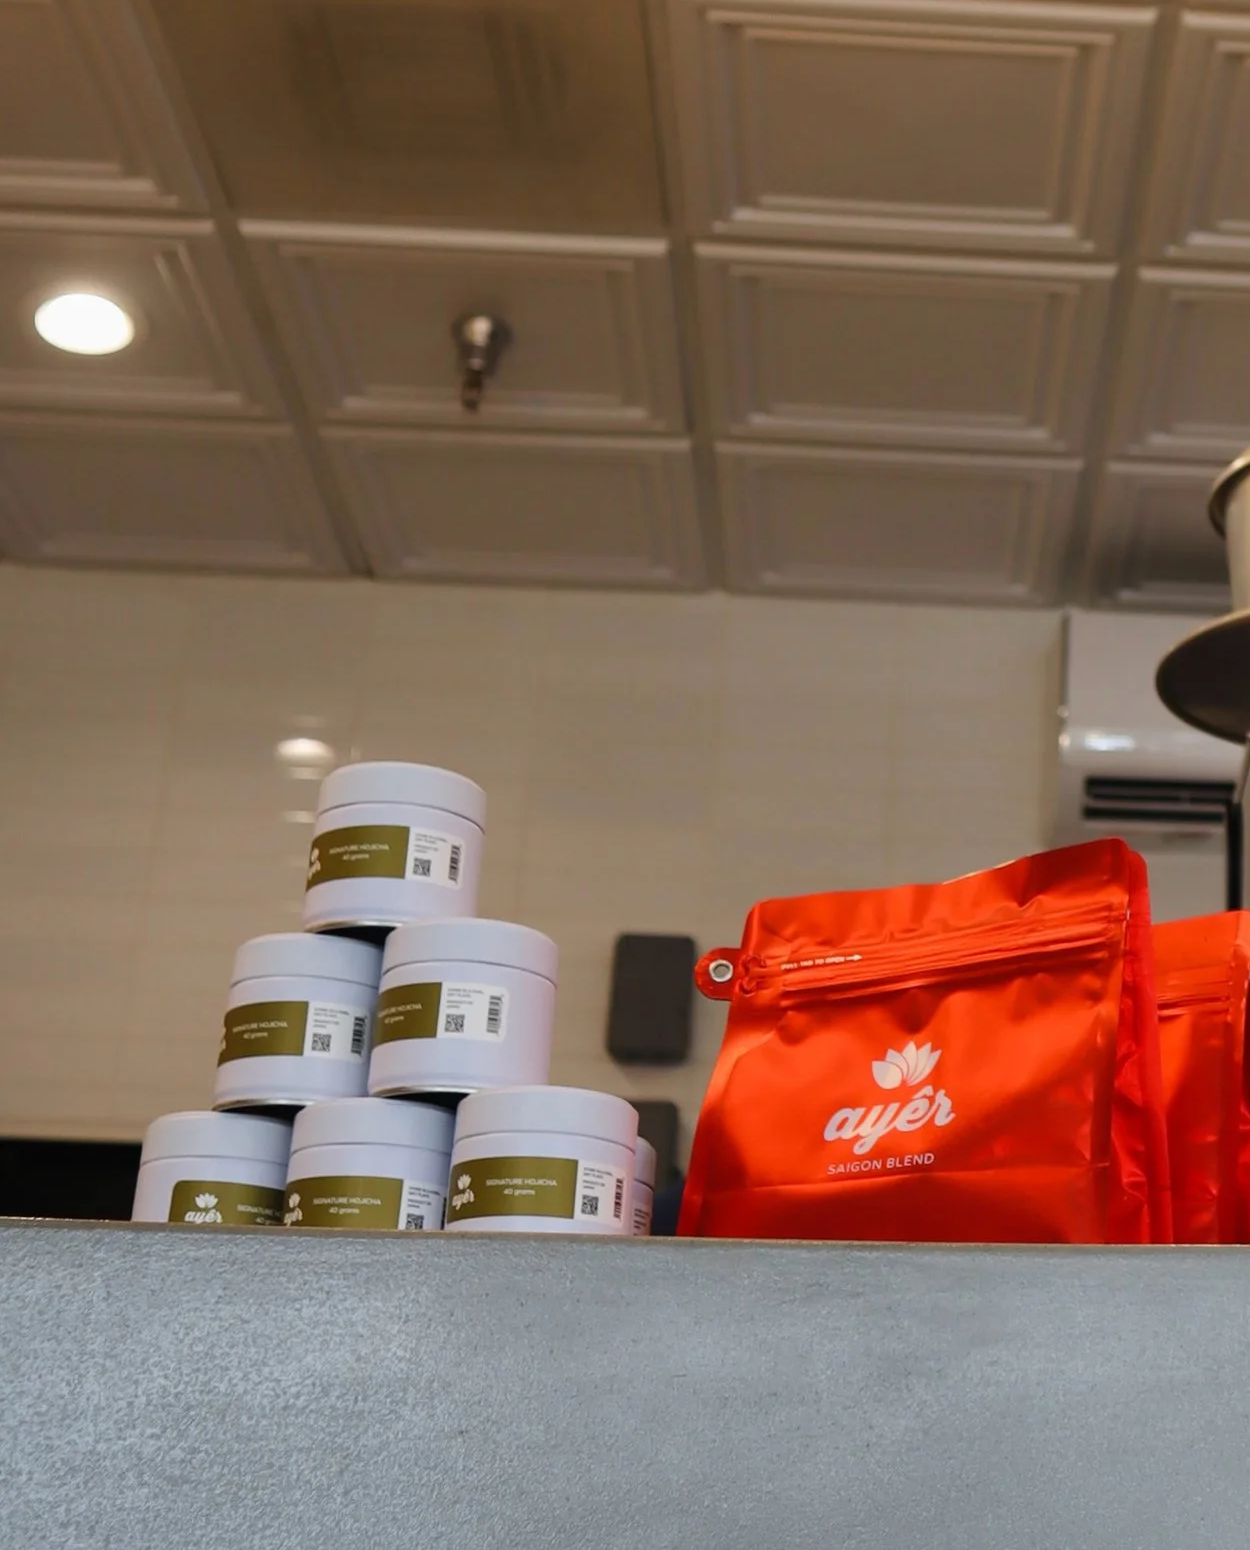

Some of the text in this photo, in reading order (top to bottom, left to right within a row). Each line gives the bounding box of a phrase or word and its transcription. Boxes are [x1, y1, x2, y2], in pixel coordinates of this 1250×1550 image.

[823, 1085, 956, 1155] ayêr
[827, 1152, 935, 1175] SAIGON BLEND
[486, 1178, 558, 1187] SIGNATURE HOJICHA
[513, 1188, 536, 1197] grams
[313, 1197, 348, 1205] SIGNATURE
[338, 1207, 360, 1215] grams
